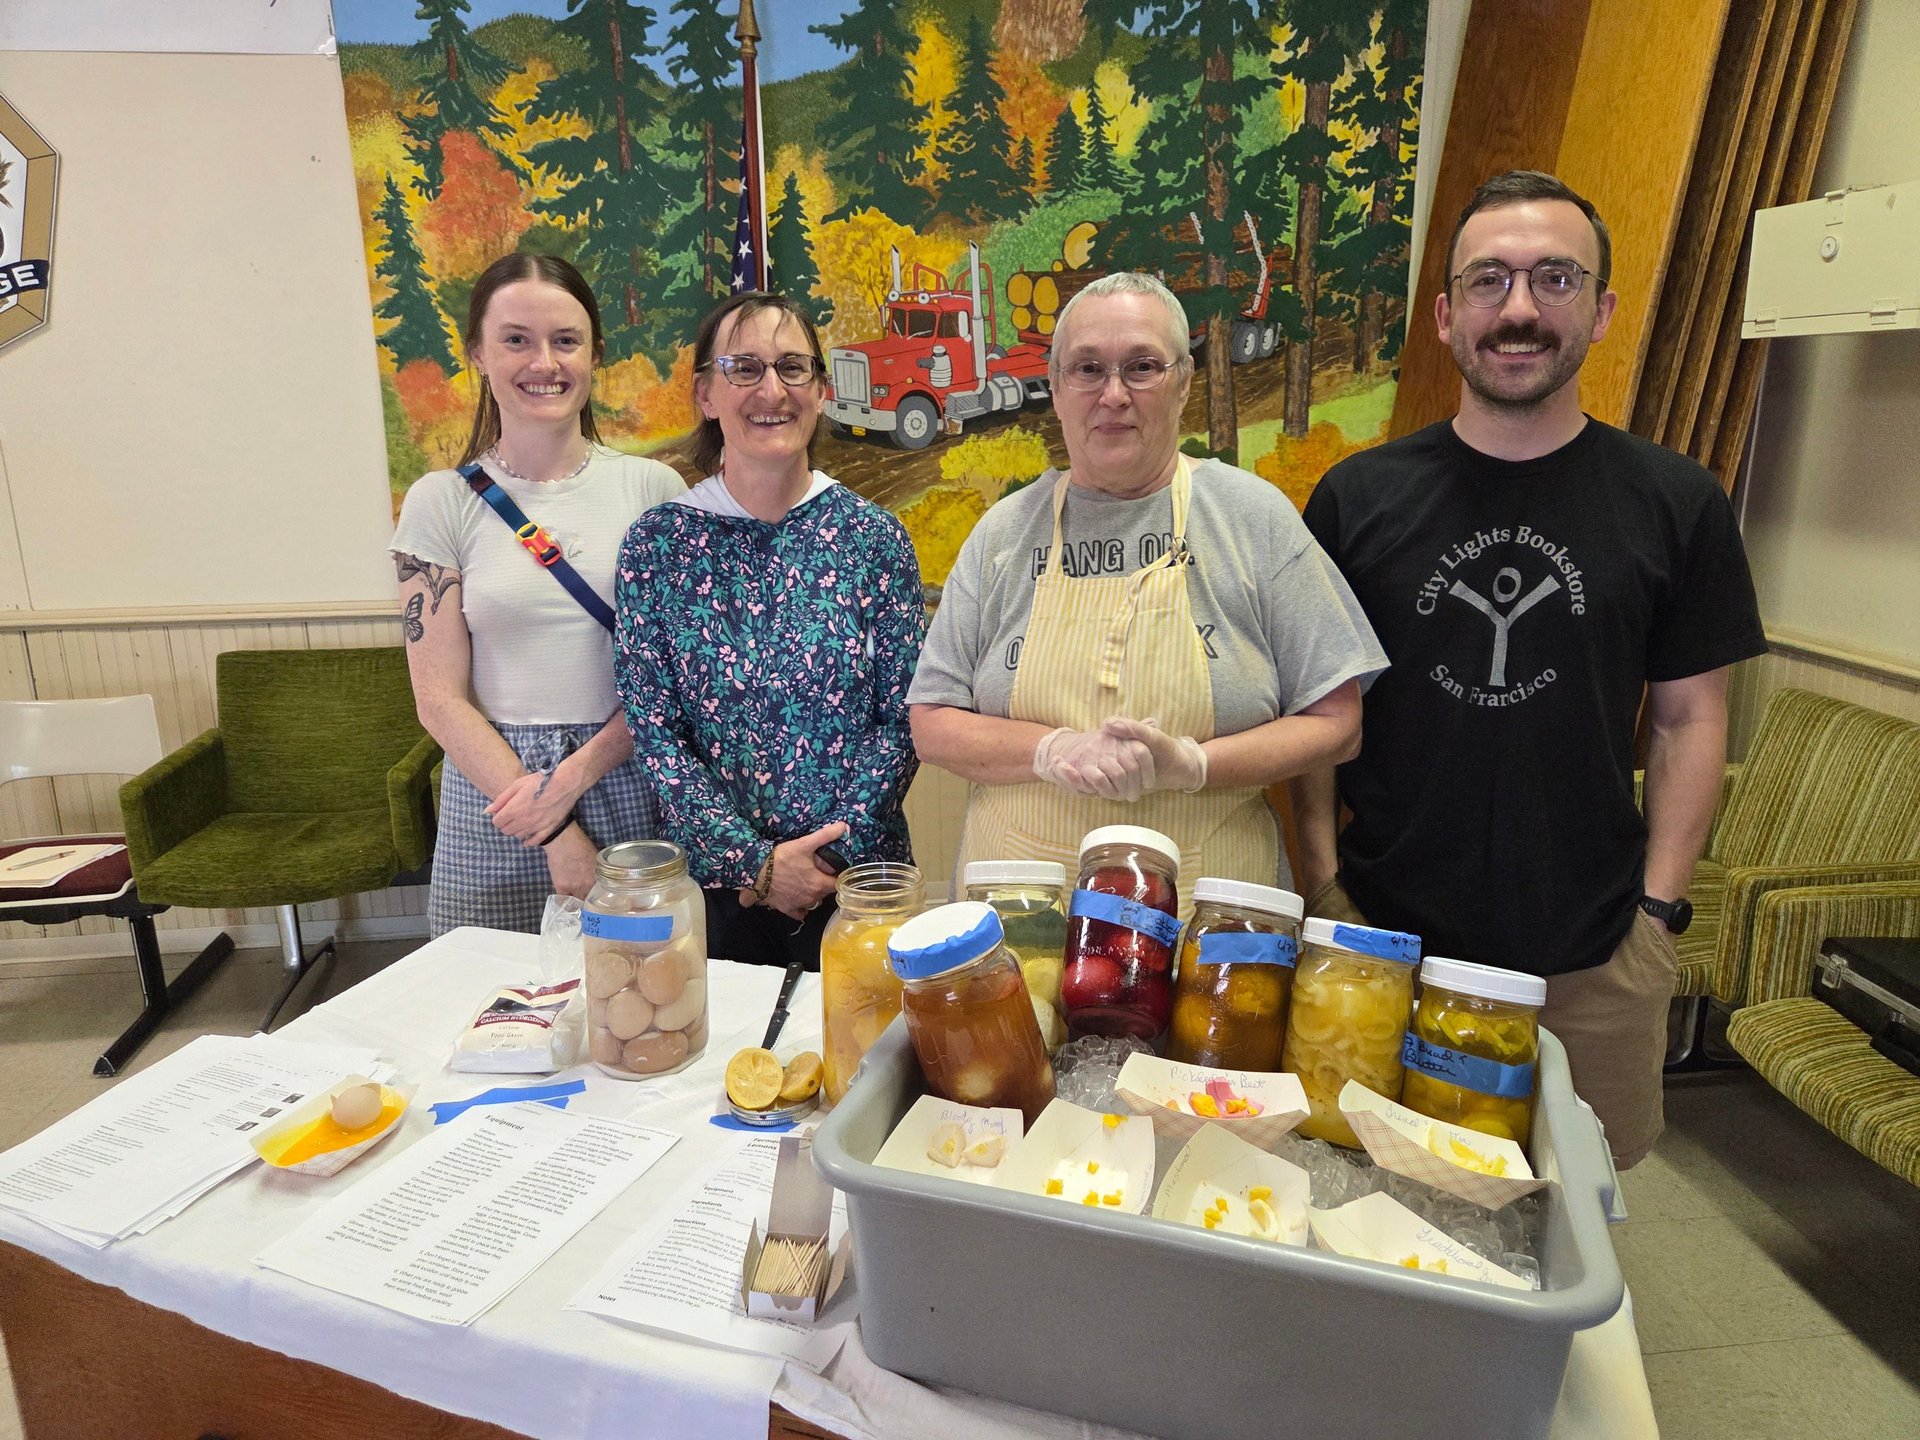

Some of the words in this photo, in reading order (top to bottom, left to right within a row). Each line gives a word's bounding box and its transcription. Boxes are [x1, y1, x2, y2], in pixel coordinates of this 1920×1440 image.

[1416, 570, 1448, 615] City
[1439, 527, 1510, 570] Lights
[1514, 525, 1586, 616] Bookstore
[1429, 664, 1464, 699] San
[1469, 668, 1557, 706] Francisco
[480, 1016, 510, 1024] CALCIUM
[1418, 1040, 1454, 1062] Bread
[485, 1114, 524, 1131] Equipment
